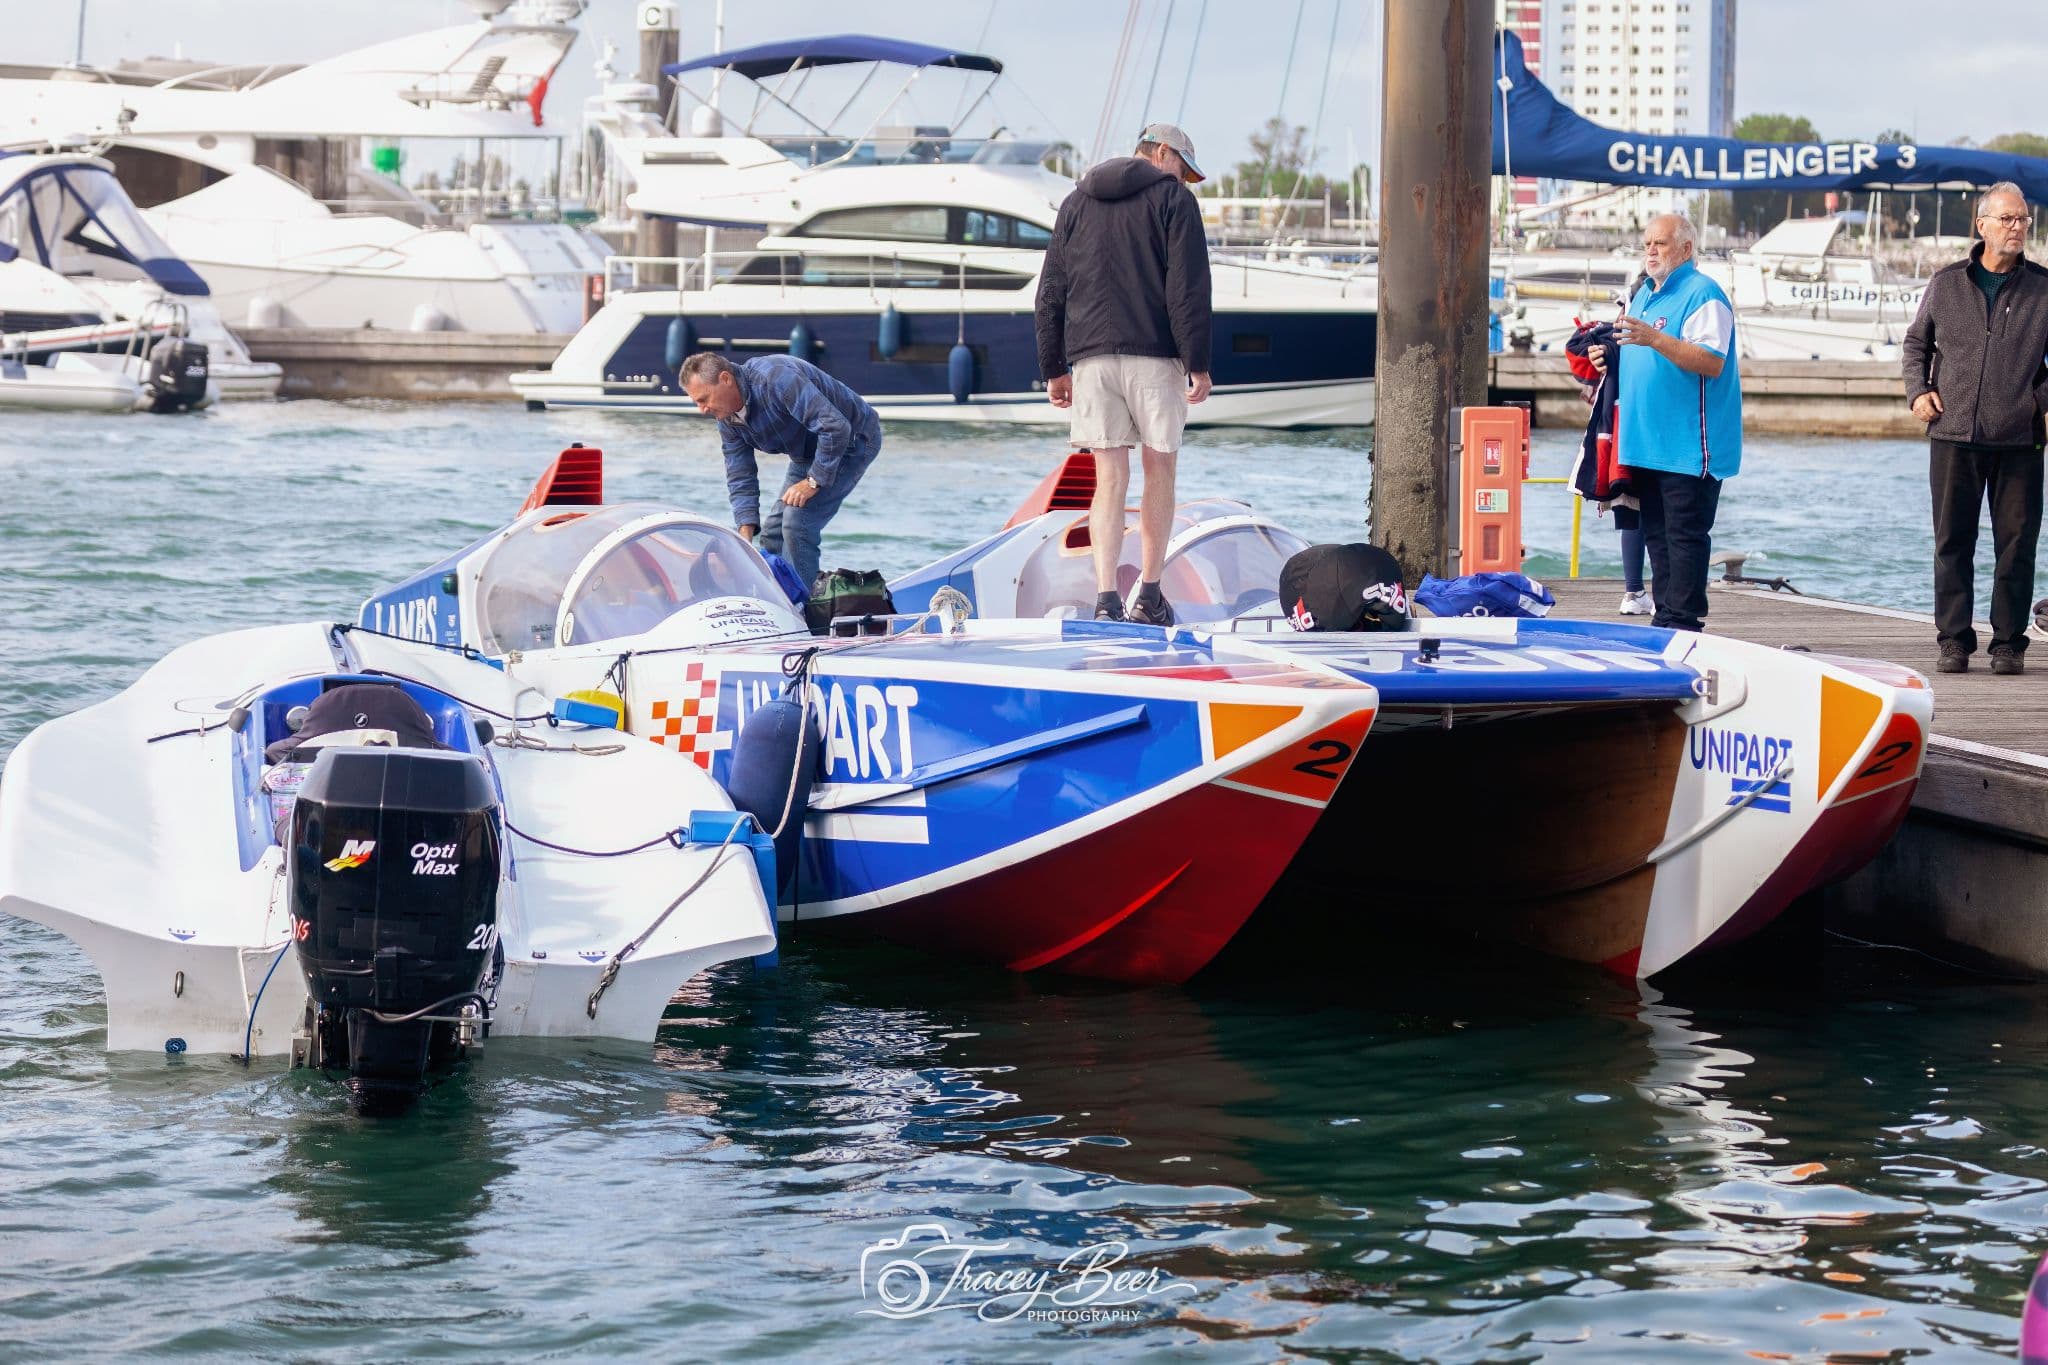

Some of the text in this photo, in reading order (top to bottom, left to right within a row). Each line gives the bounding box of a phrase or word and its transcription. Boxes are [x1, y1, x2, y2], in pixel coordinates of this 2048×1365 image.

[645, 7, 660, 26] C
[1608, 141, 1917, 181] CHALLENGER 3
[1293, 740, 1352, 780] 2
[1690, 725, 1793, 779] UNIPART
[1856, 741, 1913, 779] 2
[410, 842, 457, 861] Opti
[411, 859, 459, 875] Max
[466, 923, 497, 950] 20
